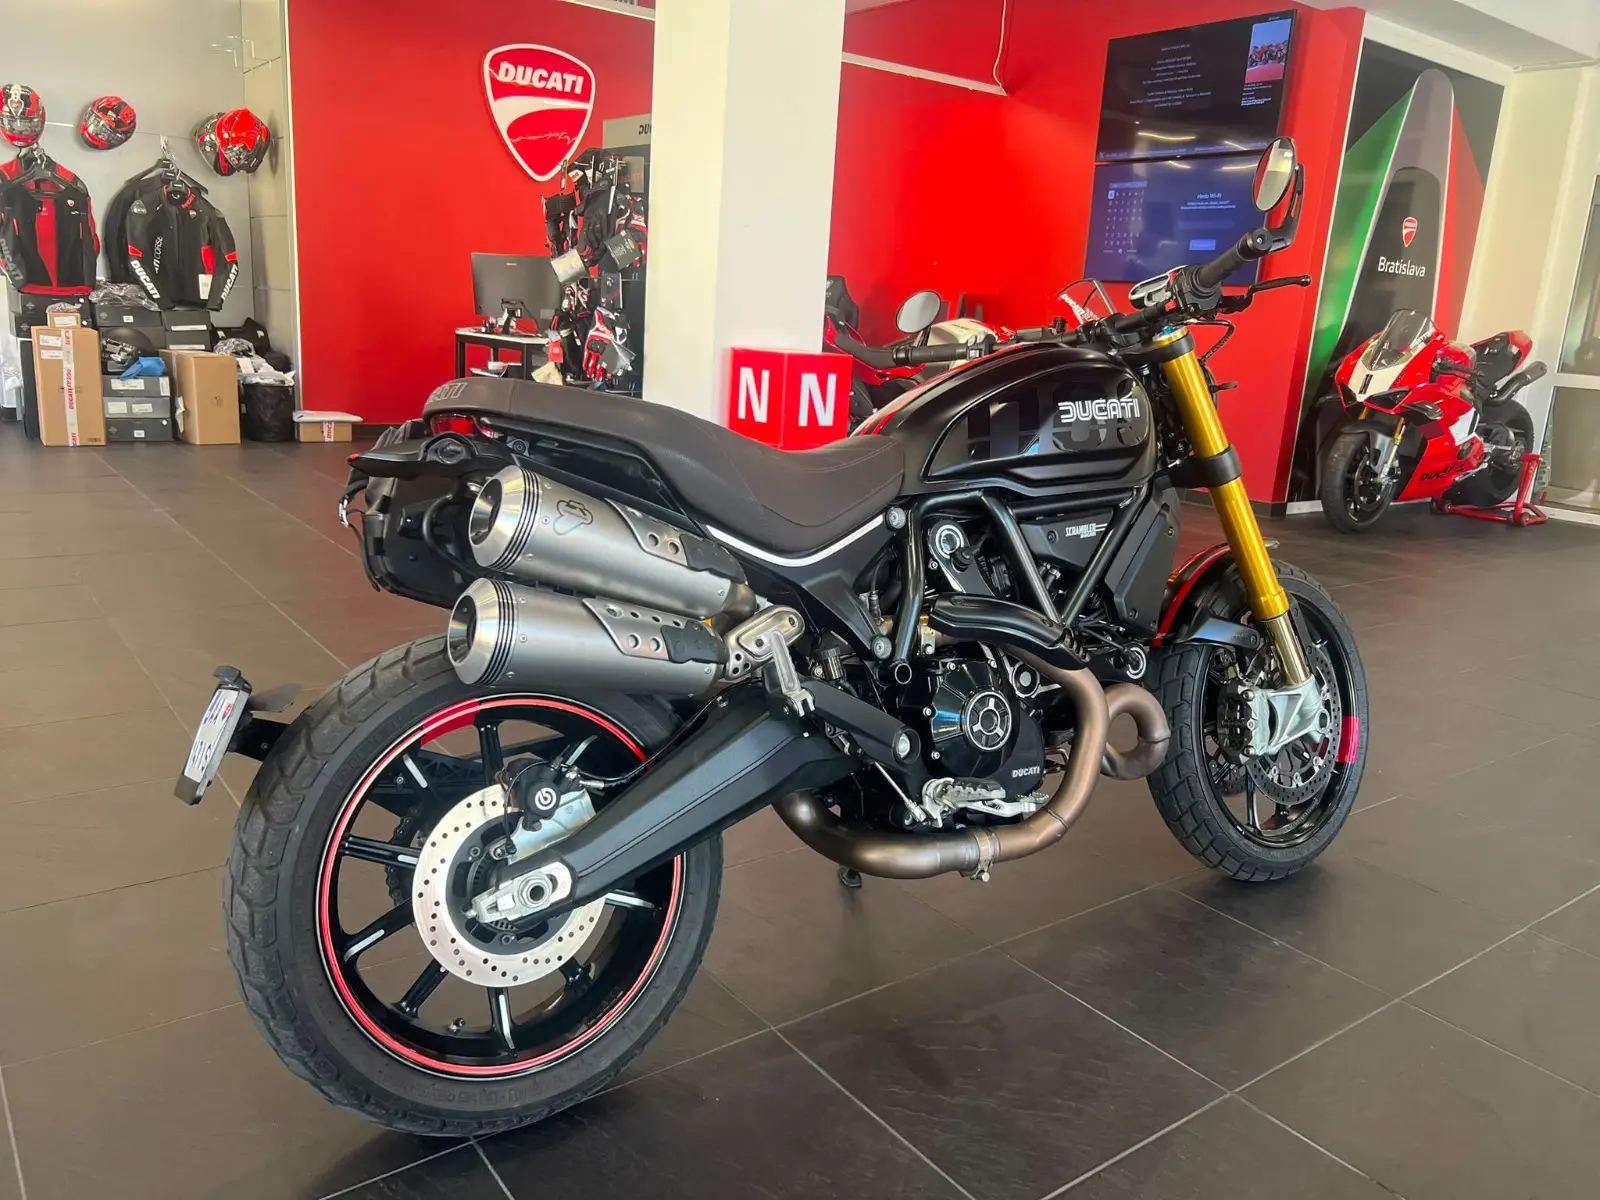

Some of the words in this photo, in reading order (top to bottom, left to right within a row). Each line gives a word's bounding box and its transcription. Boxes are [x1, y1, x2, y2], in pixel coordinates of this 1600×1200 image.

[499, 61, 584, 95] DUCATI
[0, 238, 24, 281] DUCATI
[1377, 256, 1426, 277] Bratislava
[131, 260, 161, 299] DUCATI
[221, 263, 239, 301] DUCATI
[738, 366, 770, 424] N
[798, 373, 837, 427] N
[1058, 399, 1140, 423] DUCATI
[1011, 766, 1040, 778] DUCATI
